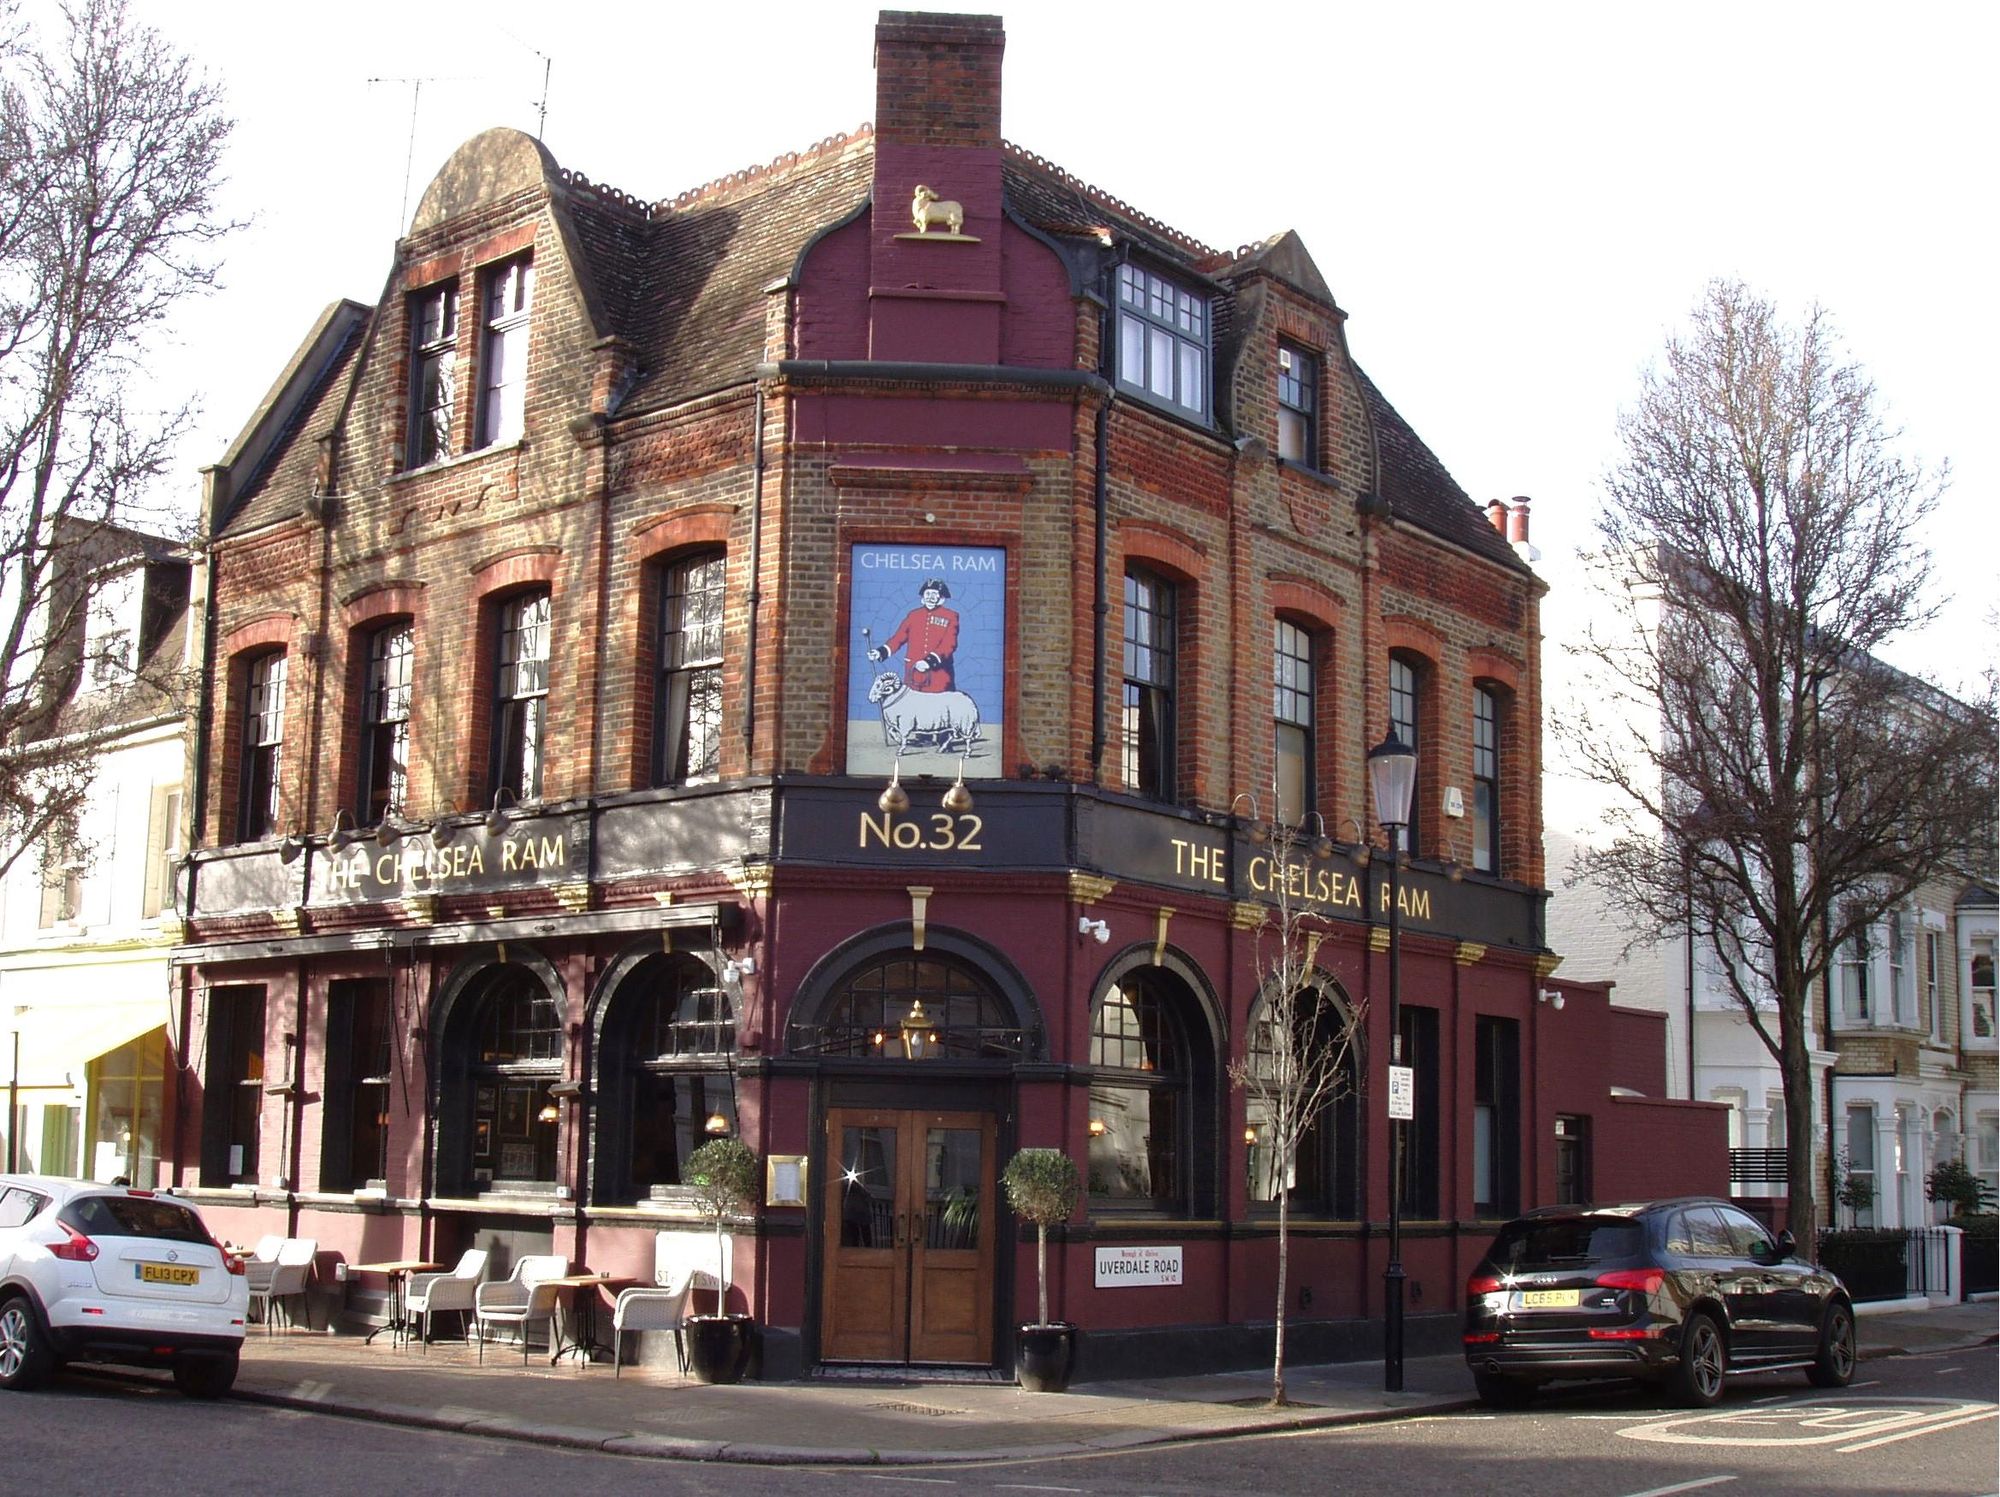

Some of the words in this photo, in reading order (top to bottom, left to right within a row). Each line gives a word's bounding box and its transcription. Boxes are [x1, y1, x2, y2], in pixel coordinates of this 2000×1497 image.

[860, 552, 945, 570] CHELSEA
[953, 555, 996, 572] RAM
[859, 812, 983, 850] No.32
[376, 844, 484, 885] CHELSEA
[502, 834, 564, 872] RAM
[1171, 839, 1226, 883] THE
[1249, 856, 1361, 908] CHELSEA
[1381, 882, 1431, 920] RAM
[145, 1266, 170, 1280] FL13
[173, 1269, 196, 1282] CPX
[1100, 1260, 1150, 1275] UVERDALE
[1154, 1259, 1179, 1273] ROAD
